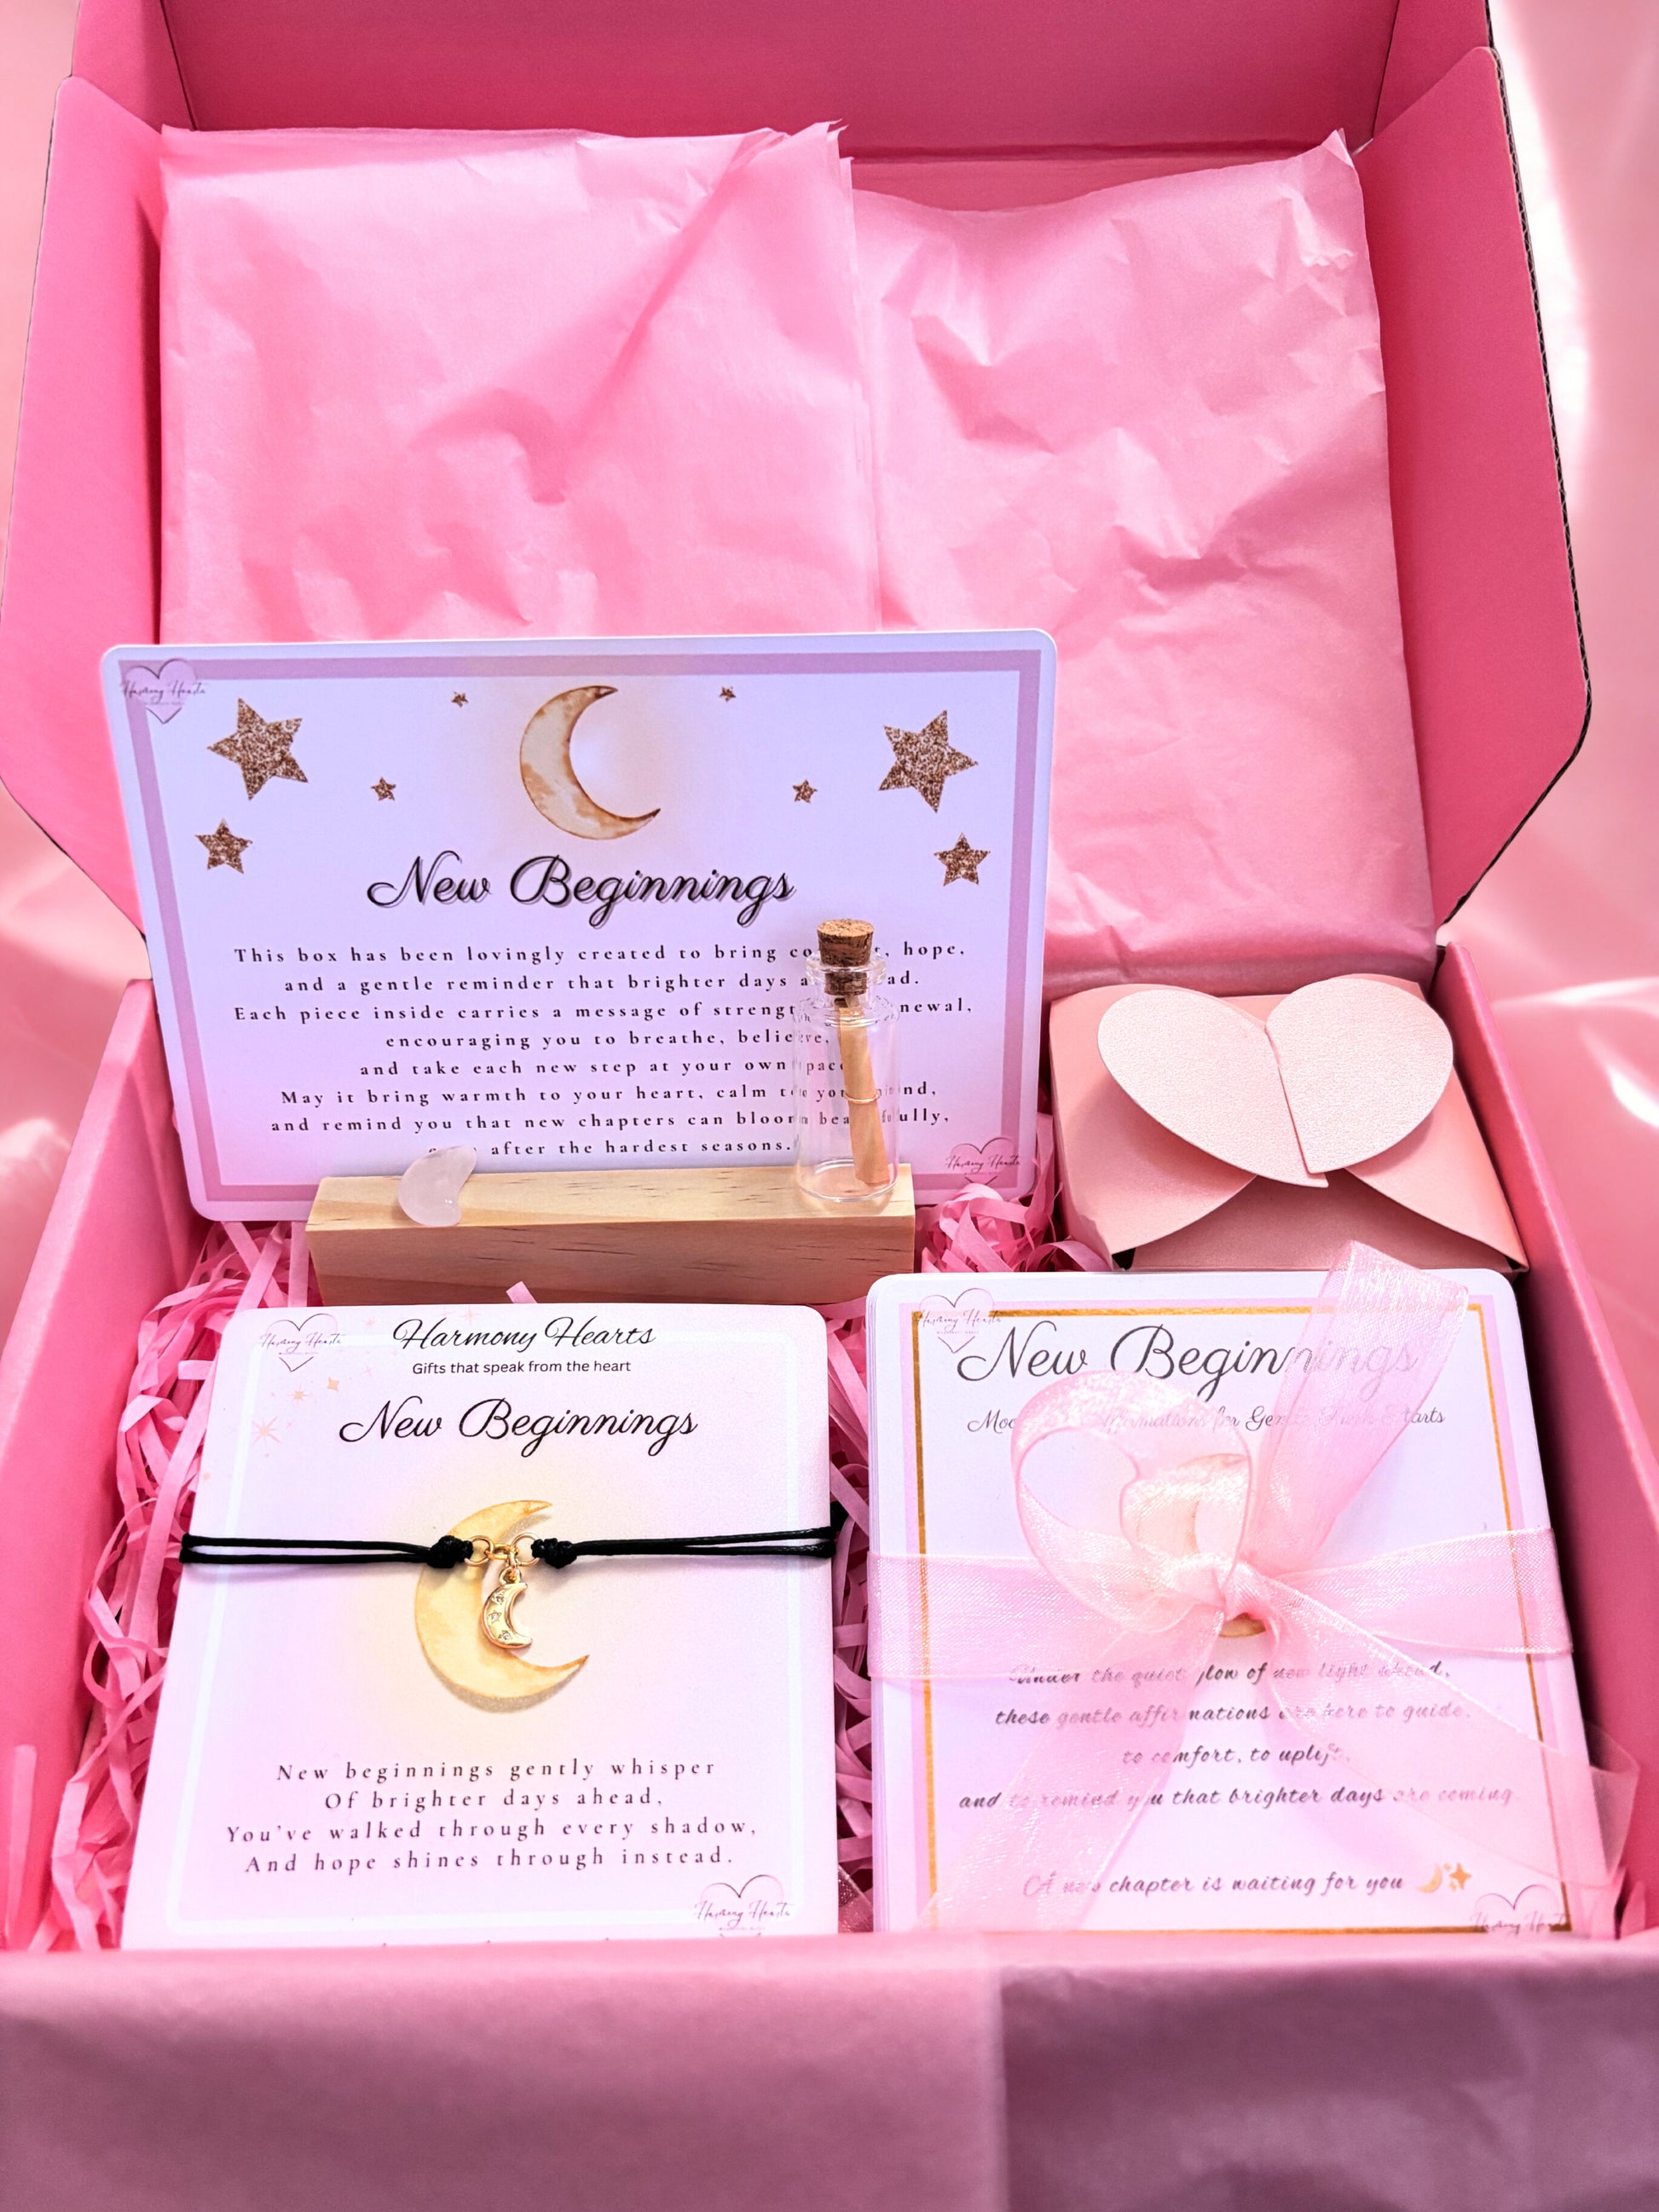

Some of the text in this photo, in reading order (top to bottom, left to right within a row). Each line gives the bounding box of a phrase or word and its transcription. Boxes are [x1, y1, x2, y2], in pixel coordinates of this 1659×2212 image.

[367, 850, 796, 929] New Beginnings
[234, 948, 284, 962] This
[298, 947, 338, 962] box
[351, 946, 387, 962] has
[401, 946, 454, 962] been
[468, 945, 564, 965] lovingly
[579, 944, 665, 960] created
[680, 947, 701, 959] to
[715, 944, 777, 963] bring
[904, 941, 965, 959] hope,
[285, 970, 919, 995] and a gentle reminder that brighter days aad.
[234, 1006, 286, 1020] Each
[300, 1006, 361, 1024] piece
[374, 1004, 444, 1019] inside
[458, 1003, 540, 1019] carries
[553, 1008, 561, 1018] a
[575, 1007, 666, 1021] message
[679, 1002, 702, 1016] of
[386, 1033, 530, 1051] encouraging
[543, 1036, 581, 1050] you
[595, 1034, 616, 1044] to
[629, 1031, 725, 1045] breathe,
[361, 1061, 398, 1075] and
[413, 1061, 460, 1075] take
[473, 1060, 522, 1075] each
[536, 1064, 577, 1073] new
[591, 1062, 636, 1077] step
[650, 1062, 669, 1071] at
[682, 1061, 731, 1076] your
[744, 1060, 786, 1071] own
[281, 1090, 323, 1107] May
[338, 1091, 355, 1103] it
[368, 1089, 429, 1106] bring
[442, 1088, 527, 1102] warmth
[540, 1090, 560, 1100] to
[574, 1091, 623, 1105] your
[637, 1086, 703, 1100] heart,
[717, 1084, 766, 1098] calm
[272, 1118, 309, 1131] and
[323, 1117, 401, 1131] remind
[415, 1118, 452, 1134] you
[466, 1115, 511, 1129] that
[525, 1118, 564, 1128] new
[579, 1113, 675, 1130] chapters
[688, 1116, 723, 1125] can
[491, 1141, 546, 1155] after
[558, 1141, 592, 1153] the
[606, 1140, 689, 1153] hardest
[702, 1141, 791, 1152] seasons.
[392, 1315, 656, 1352] Harmony Hearts
[412, 1358, 632, 1376] Gifts that speak from the heart
[957, 1320, 1419, 1402] New Beginnings
[339, 1395, 699, 1458] New Beginnings
[1092, 1666, 1122, 1683] the
[1131, 1666, 1185, 1689] quiet
[1246, 1662, 1268, 1685] of
[995, 1708, 1050, 1724] these
[1056, 1707, 1122, 1730] gentle
[1375, 1703, 1395, 1718] to
[1122, 1749, 1144, 1764] to
[1250, 1747, 1270, 1762] to
[277, 1758, 714, 1784] New beginnings gently whisper
[325, 1787, 662, 1813] Of brighter days ahead,
[959, 1792, 1003, 1808] and
[1042, 1789, 1119, 1807] remind
[1172, 1789, 1221, 1805] that
[1228, 1788, 1321, 1809] brighter
[1330, 1788, 1383, 1808] days
[329, 1821, 421, 1839] walked
[439, 1818, 545, 1841] through
[563, 1822, 633, 1839] every
[650, 1816, 756, 1836] shadow,
[246, 1845, 733, 1875] And hope shines through instead.
[1109, 1874, 1194, 1898] chapter
[1202, 1875, 1223, 1891] is
[1231, 1872, 1316, 1896] waiting
[1321, 1870, 1358, 1897] for
[1365, 1875, 1403, 1895] you
